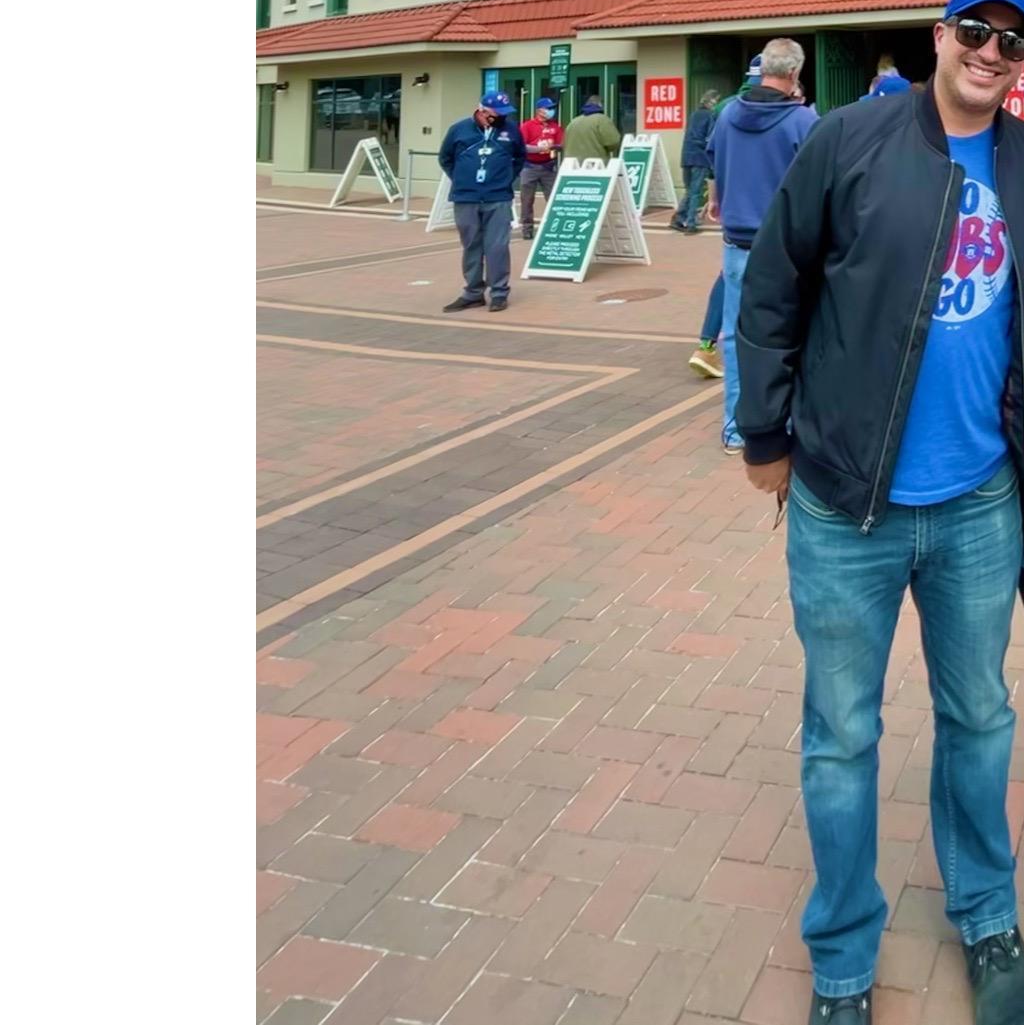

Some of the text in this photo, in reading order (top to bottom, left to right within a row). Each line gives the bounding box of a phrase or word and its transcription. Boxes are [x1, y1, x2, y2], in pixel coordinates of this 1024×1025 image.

[650, 84, 677, 102] RED
[645, 105, 682, 124] ZONE
[960, 182, 980, 216] O
[943, 216, 1007, 279] BS
